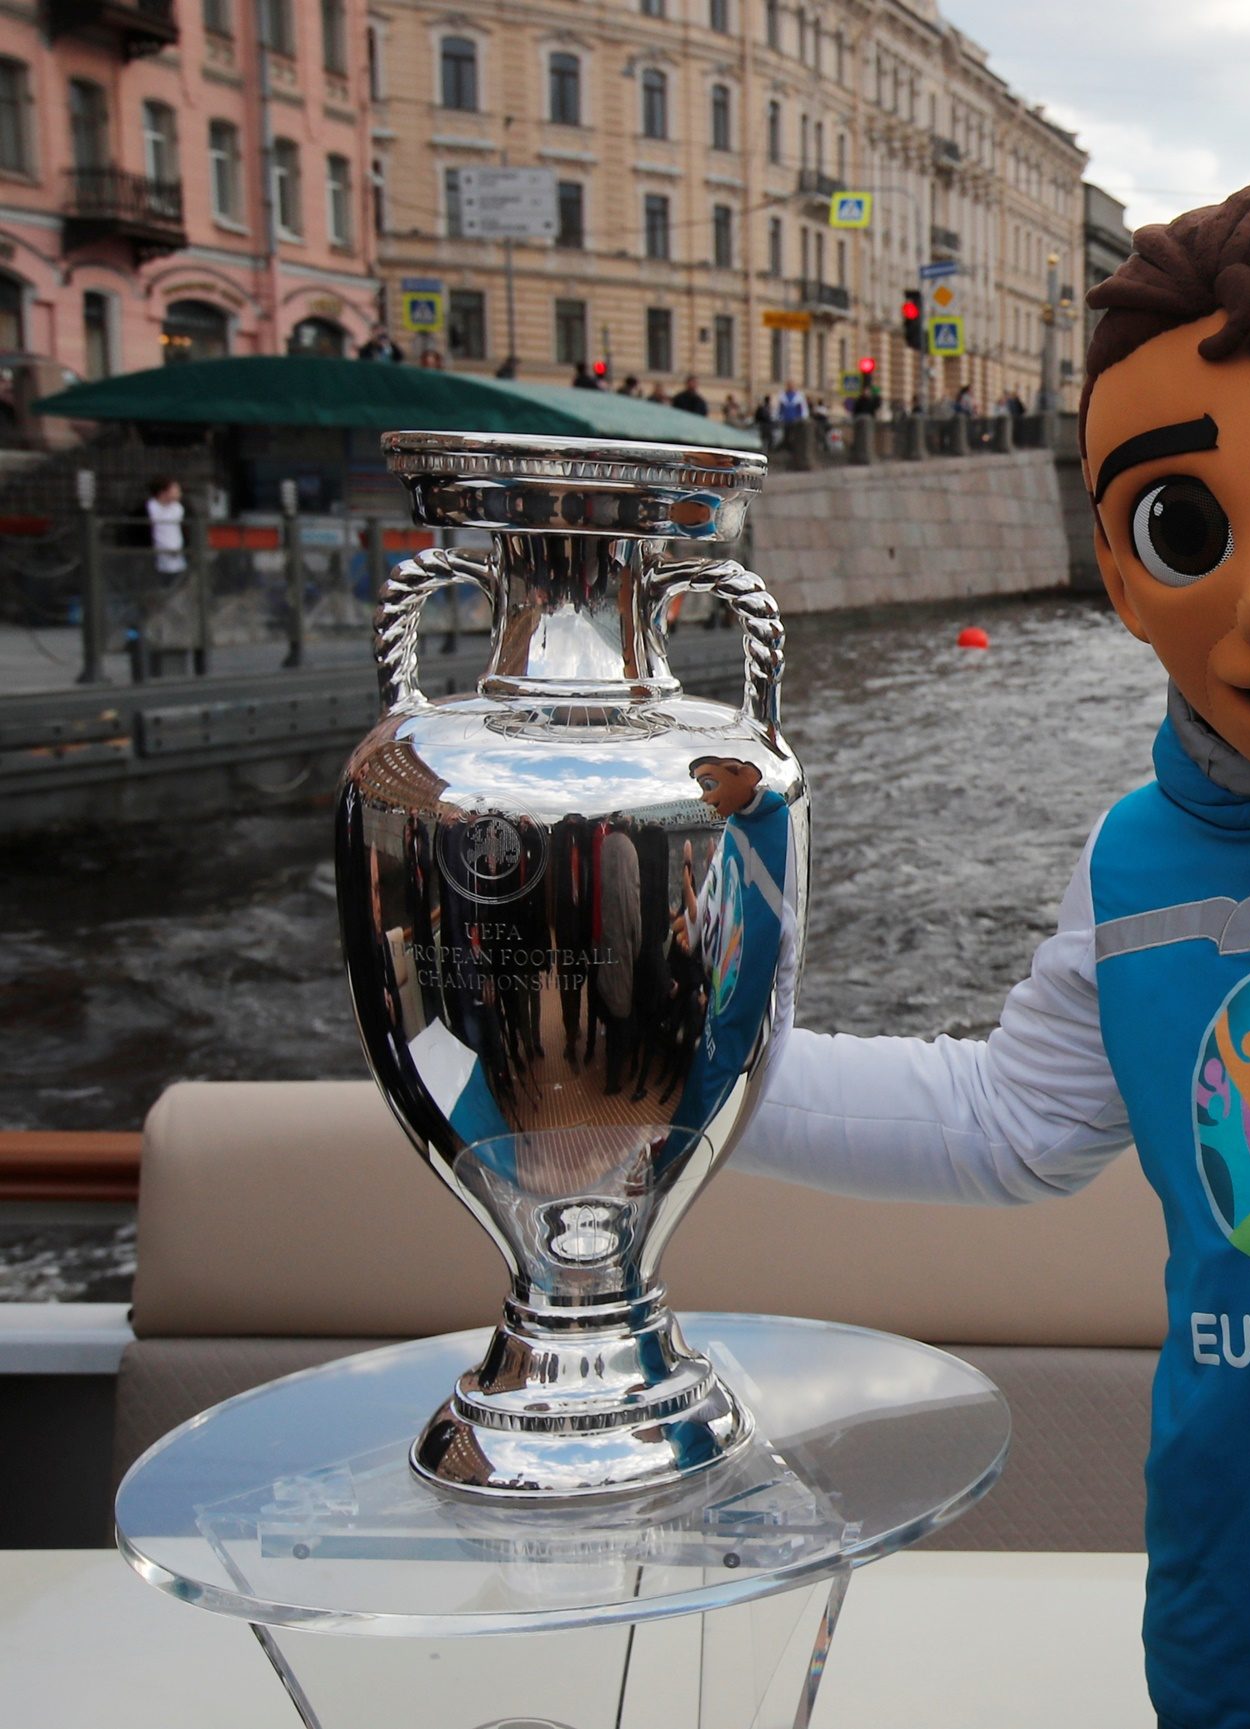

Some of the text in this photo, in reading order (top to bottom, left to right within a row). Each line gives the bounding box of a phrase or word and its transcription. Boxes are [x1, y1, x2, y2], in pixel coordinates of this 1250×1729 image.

[464, 922, 523, 941] UEFA
[377, 941, 620, 969] UROPEAN FOOTBALL
[417, 968, 587, 992] CHAMPIONSHIP
